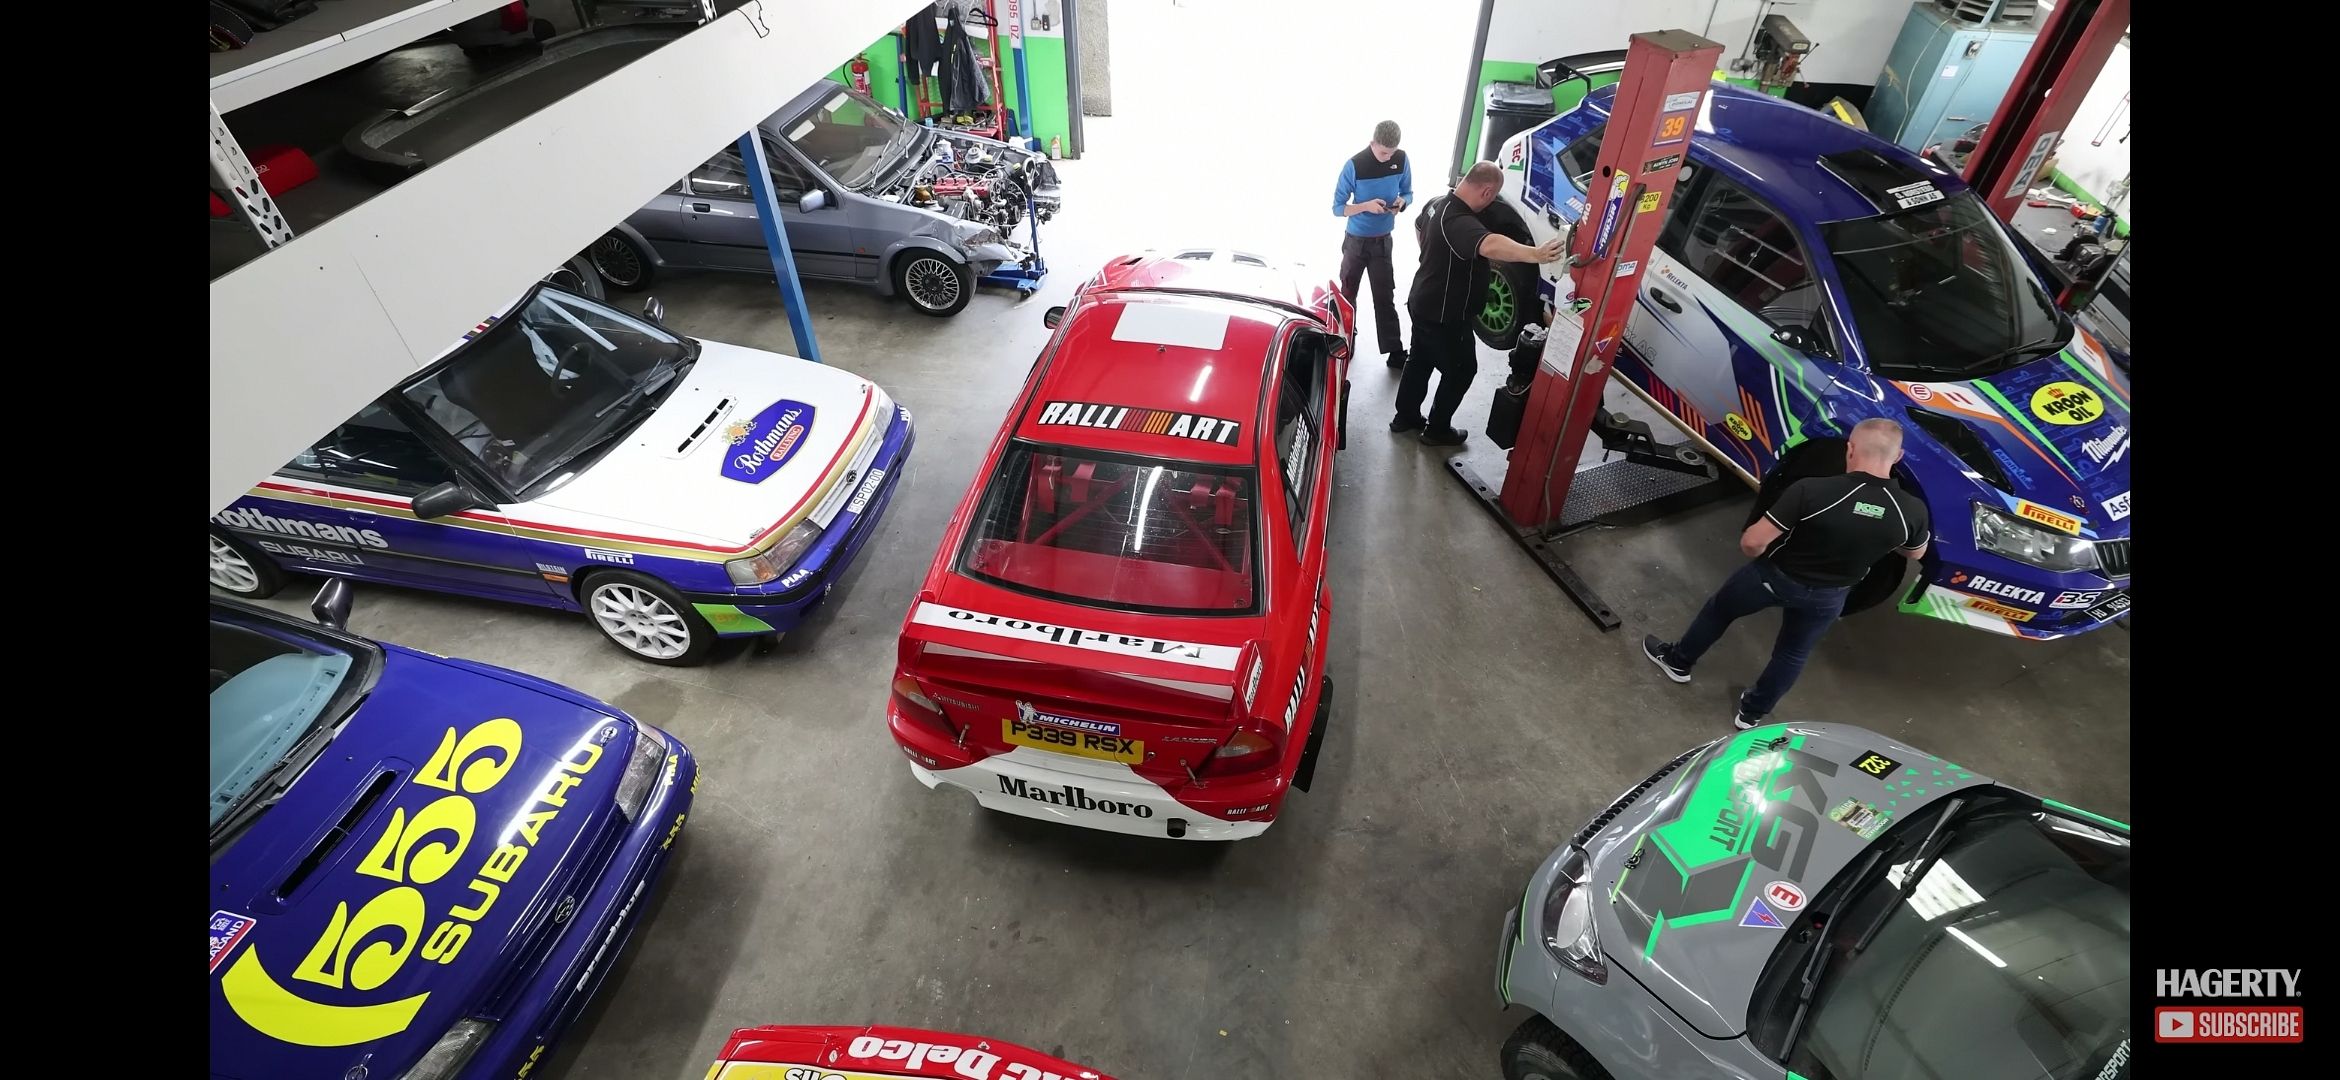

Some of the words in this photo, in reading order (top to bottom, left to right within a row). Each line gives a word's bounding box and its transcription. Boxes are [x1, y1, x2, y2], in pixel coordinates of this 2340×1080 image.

[1661, 116, 1685, 139] 39
[2042, 390, 2094, 416] KROON
[2068, 406, 2095, 421] OIL
[1038, 401, 1129, 431] RALLI
[1168, 416, 1239, 445] ART
[1729, 417, 1749, 436] KROON
[734, 408, 803, 475] Rothmans
[774, 427, 801, 460] RALLYING
[2023, 504, 2077, 531] PIRELLI
[259, 540, 365, 566] SUBARU
[584, 548, 634, 565] PIRELLI
[536, 562, 568, 575] BILSTEIN
[1968, 575, 2046, 605] RELEKTA
[1971, 600, 2031, 620] PIRELLI
[948, 609, 1202, 659] Marlboro
[1037, 713, 1117, 733] MICHELIN
[1011, 721, 1077, 747] P339
[1084, 733, 1135, 755] RSX
[1858, 755, 1892, 774] 322
[996, 773, 1154, 820] Marlboro
[292, 718, 523, 991] 555
[421, 742, 604, 965] SUBARU
[576, 879, 647, 993] prodrive
[848, 1036, 1002, 1080] Delco
